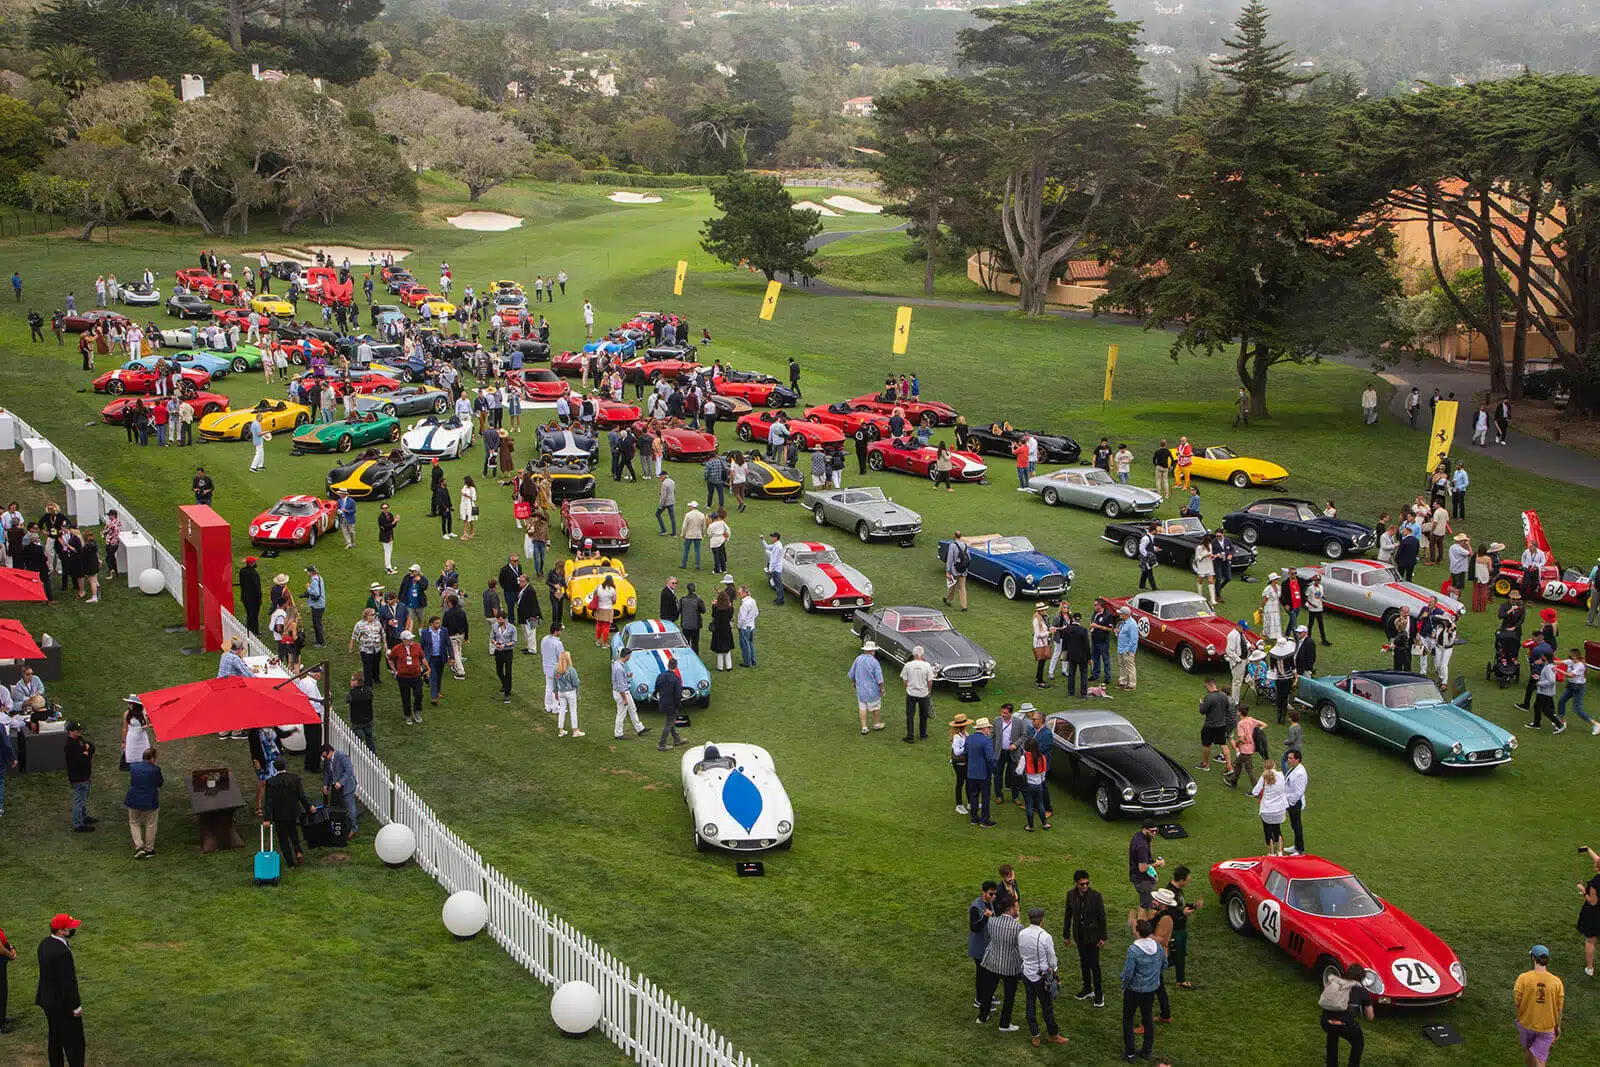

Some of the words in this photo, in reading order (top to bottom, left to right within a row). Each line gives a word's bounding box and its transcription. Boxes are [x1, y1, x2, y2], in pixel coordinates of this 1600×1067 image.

[1545, 584, 1564, 597] 34
[1138, 620, 1149, 634] 36
[1262, 903, 1278, 938] 24
[1394, 963, 1436, 986] 24
